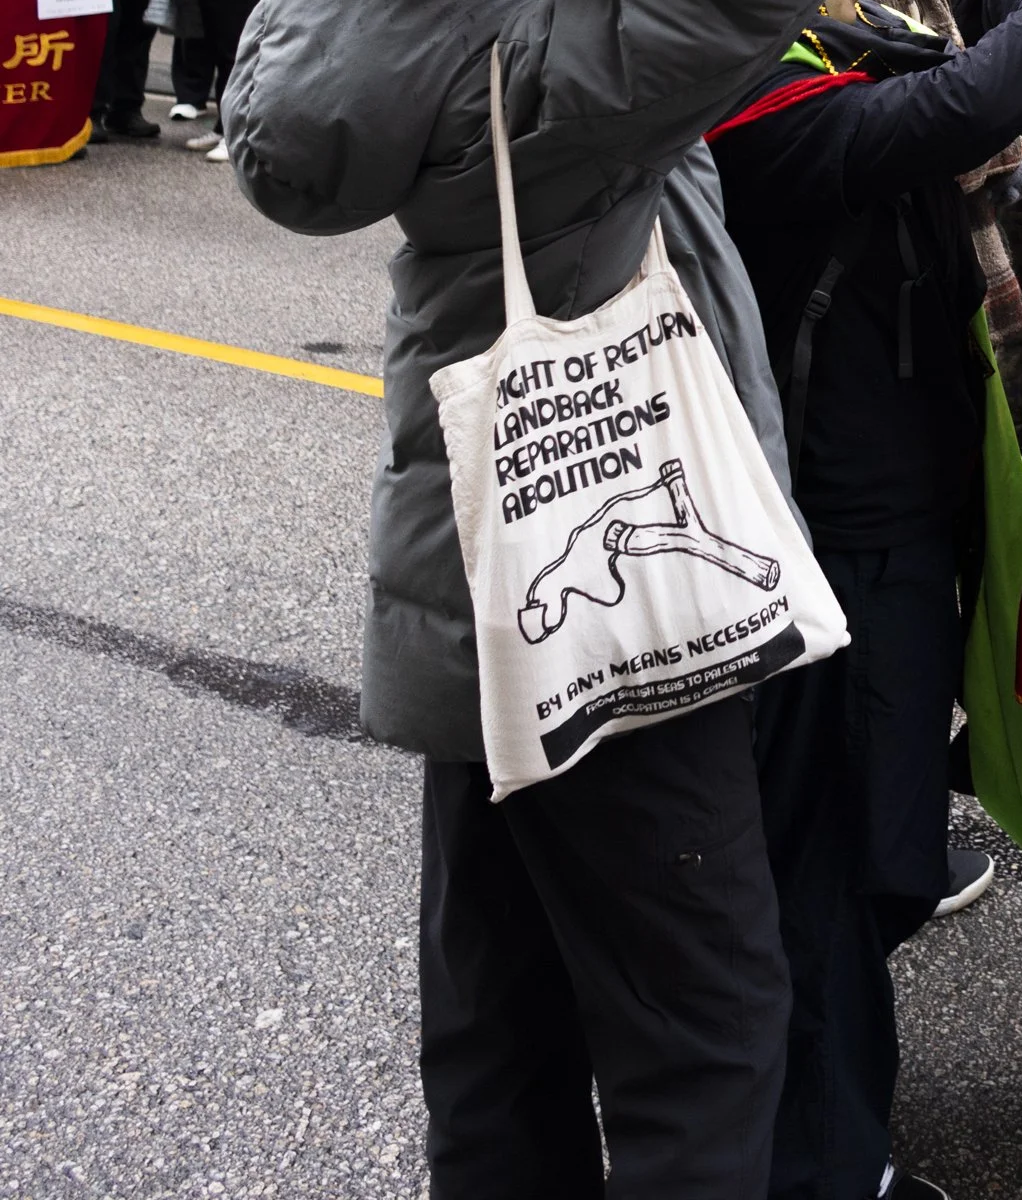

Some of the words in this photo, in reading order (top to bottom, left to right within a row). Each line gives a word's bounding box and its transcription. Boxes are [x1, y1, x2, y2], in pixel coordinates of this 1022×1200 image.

[2, 30, 75, 71] 所
[564, 352, 598, 383] OF
[603, 312, 696, 372] RETURN
[494, 378, 623, 450] LANDBACK
[495, 391, 670, 487] REPARATIONS
[502, 443, 643, 524] ABOLITION
[536, 693, 562, 720] BY
[566, 669, 604, 701] ANY
[609, 645, 682, 677] MEANS
[687, 595, 789, 657] NECESSARY
[585, 693, 616, 715] FROM
[657, 679, 685, 695] SEAS
[686, 674, 702, 688] TO
[704, 652, 760, 683] PALESTINE
[680, 693, 691, 705] IS
[693, 691, 701, 700] A
